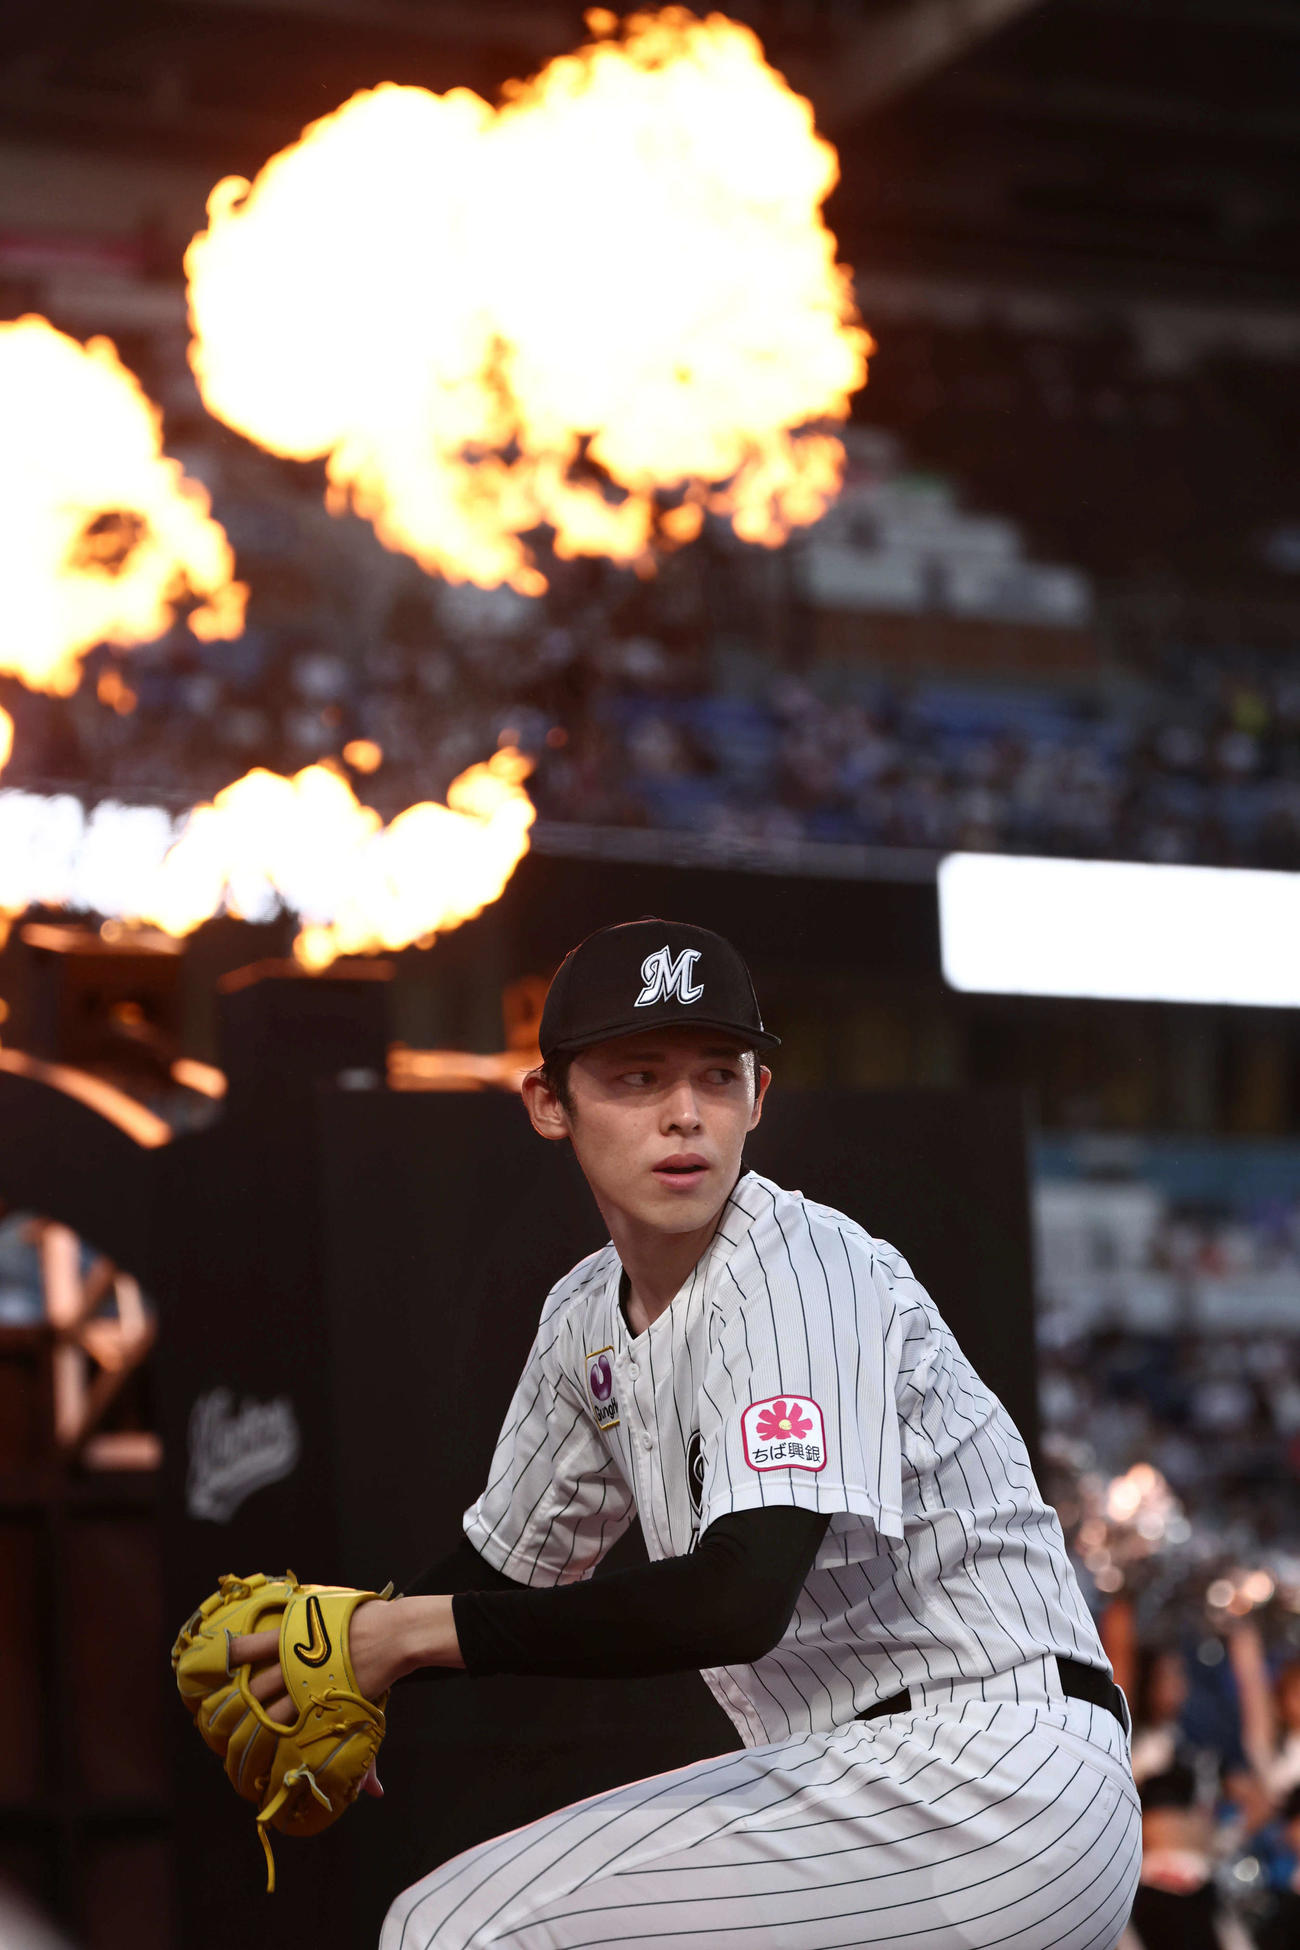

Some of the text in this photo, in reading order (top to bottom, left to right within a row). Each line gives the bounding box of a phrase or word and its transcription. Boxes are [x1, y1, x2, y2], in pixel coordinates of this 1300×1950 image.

[634, 944, 704, 1007] M
[594, 1397, 618, 1421] GungH
[752, 1442, 820, 1463] ちば興銀
